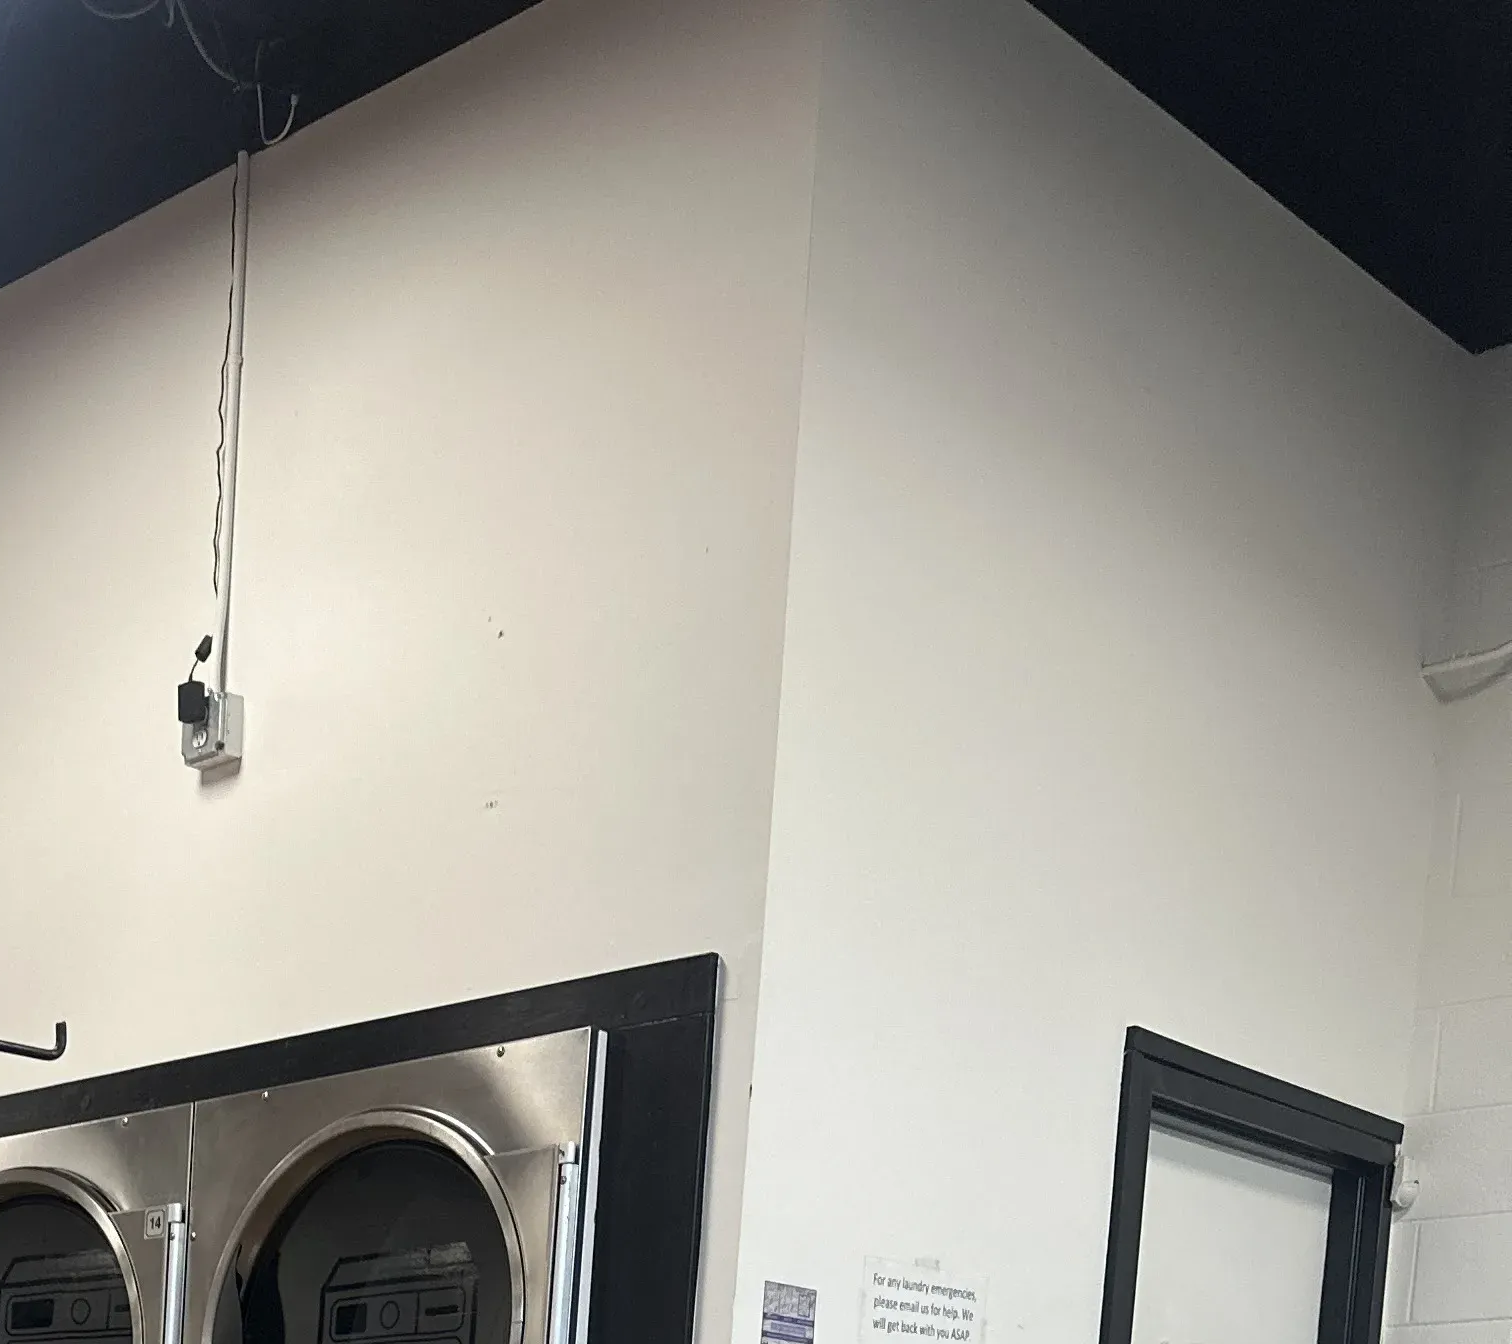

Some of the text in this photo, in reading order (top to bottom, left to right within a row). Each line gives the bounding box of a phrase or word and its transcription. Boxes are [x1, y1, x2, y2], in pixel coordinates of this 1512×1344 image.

[150, 1216, 161, 1229] 14
[873, 1273, 977, 1302] For any laundry emergencies,
[873, 1295, 974, 1321] please email us for help. We
[872, 1317, 886, 1329] will
[887, 1321, 899, 1334] get
[901, 1320, 917, 1334] back
[919, 1324, 935, 1336] with
[936, 1328, 949, 1340] you
